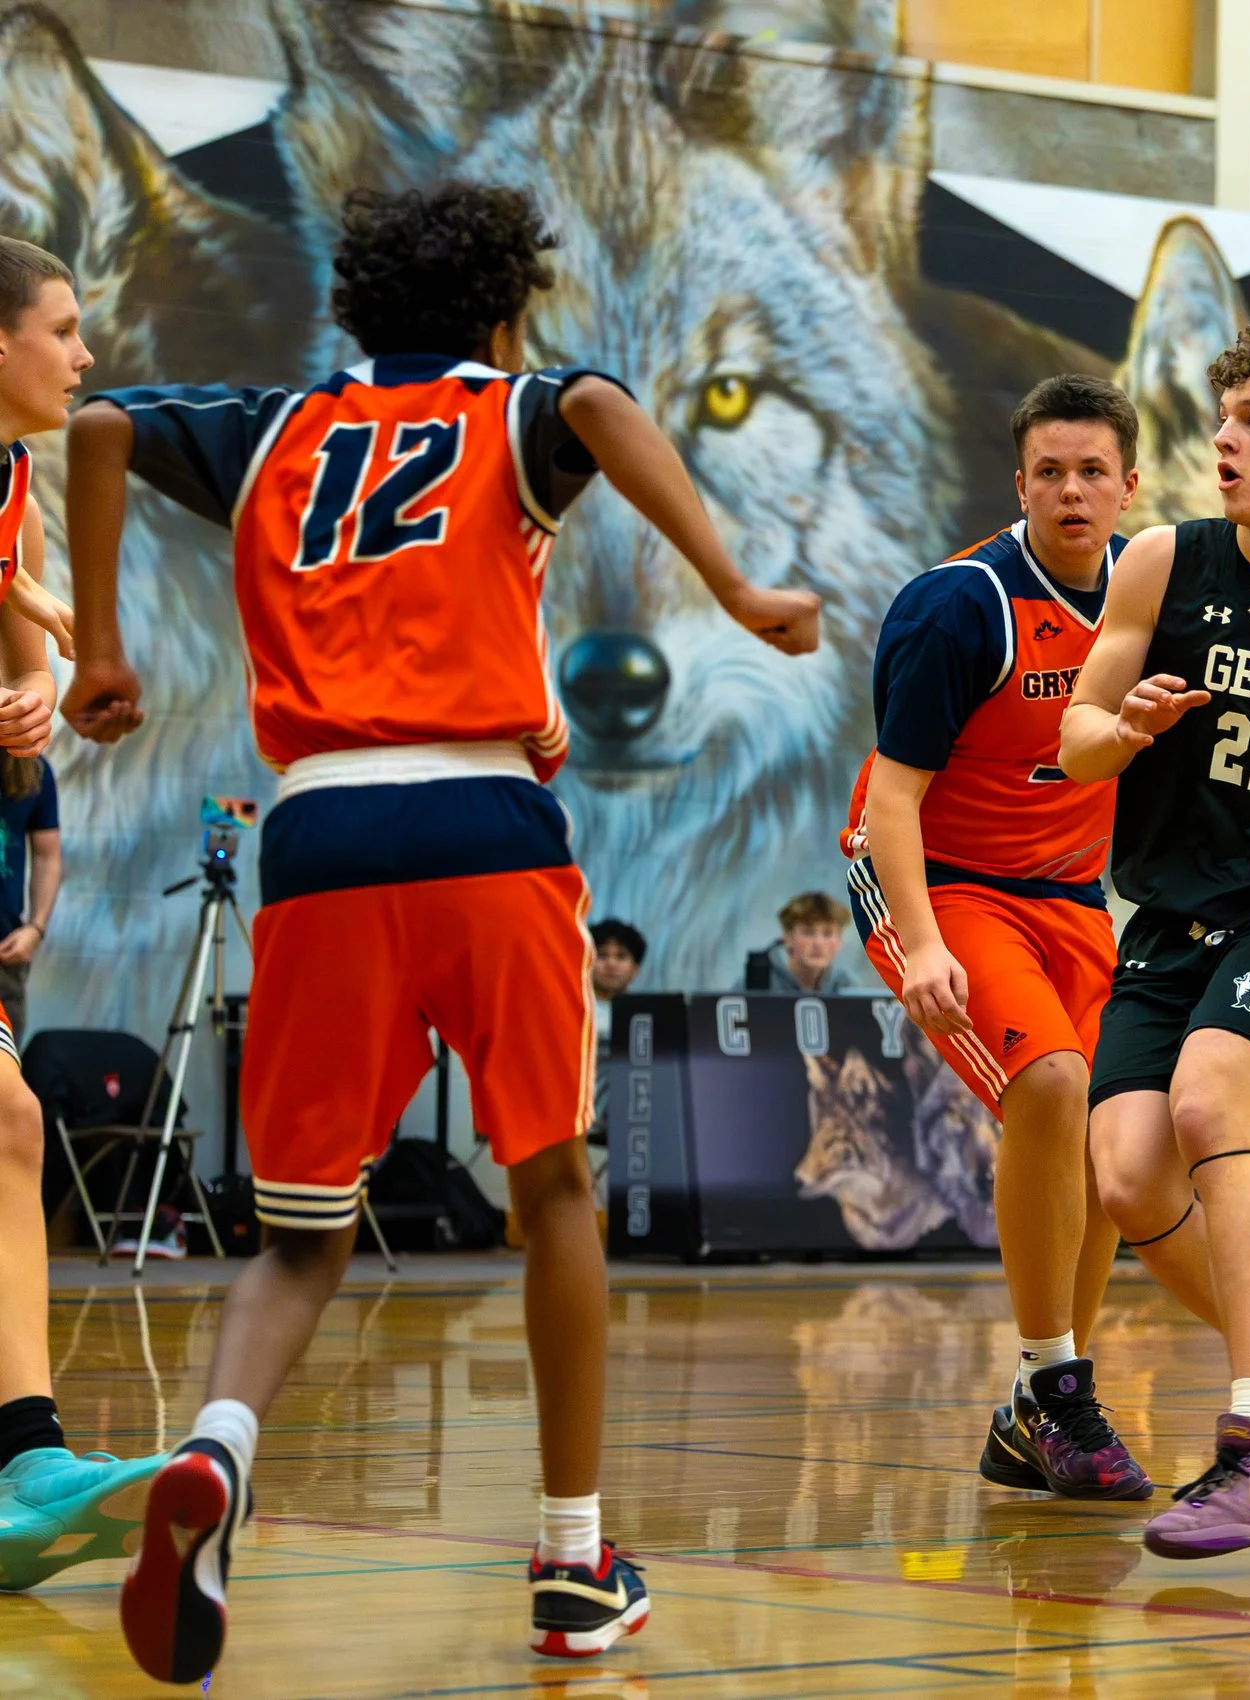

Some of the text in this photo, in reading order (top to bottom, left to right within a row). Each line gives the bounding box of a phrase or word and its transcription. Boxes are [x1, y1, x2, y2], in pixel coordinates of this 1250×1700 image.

[291, 411, 466, 572] 12
[1021, 664, 1083, 701] GRY
[1003, 1031, 1028, 1054] adidas
